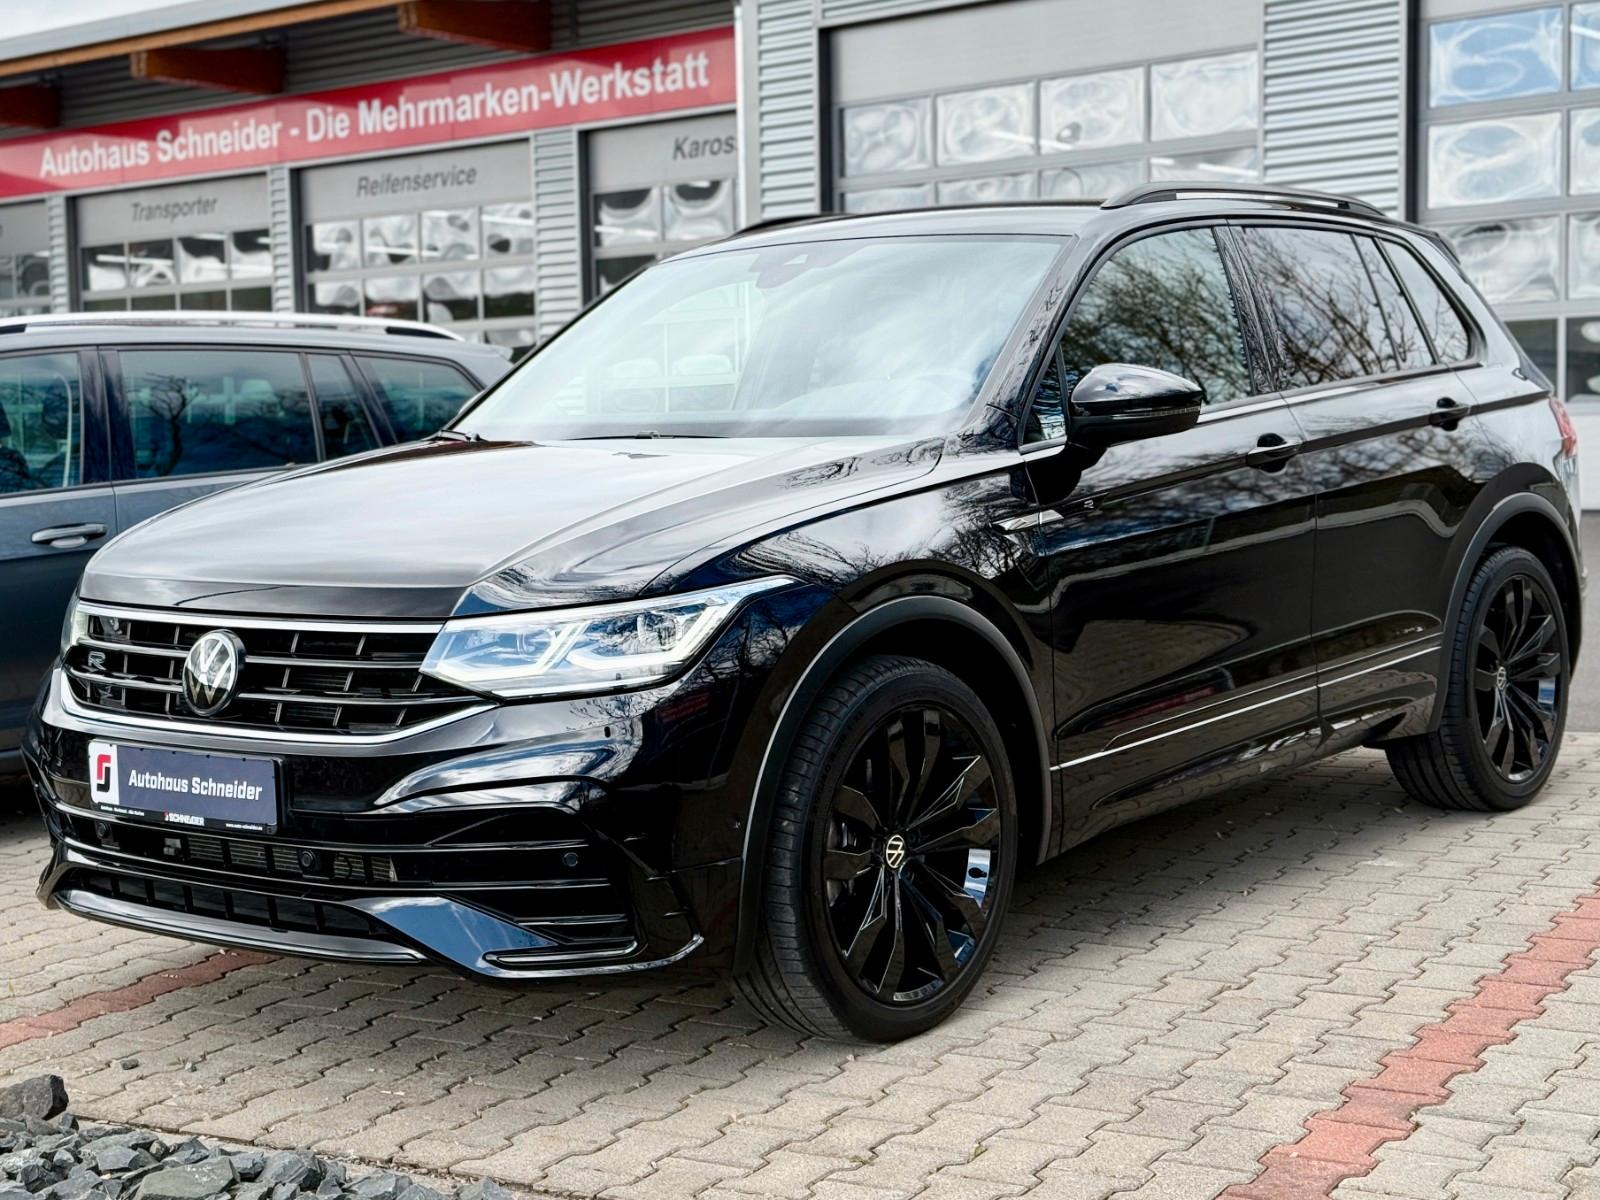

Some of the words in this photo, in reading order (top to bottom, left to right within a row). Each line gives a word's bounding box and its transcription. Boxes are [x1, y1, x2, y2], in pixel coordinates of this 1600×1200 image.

[40, 138, 150, 178] Autohaus
[156, 119, 281, 163] Schneider
[306, 106, 350, 143] Die
[357, 50, 710, 135] Mehrmarken-Werkstatt
[672, 135, 737, 160] Karos
[356, 164, 477, 198] Reifenservice
[130, 195, 219, 222] Transporter
[88, 650, 107, 671] R
[129, 769, 189, 793] Autohaus
[191, 776, 263, 801] Schneider
